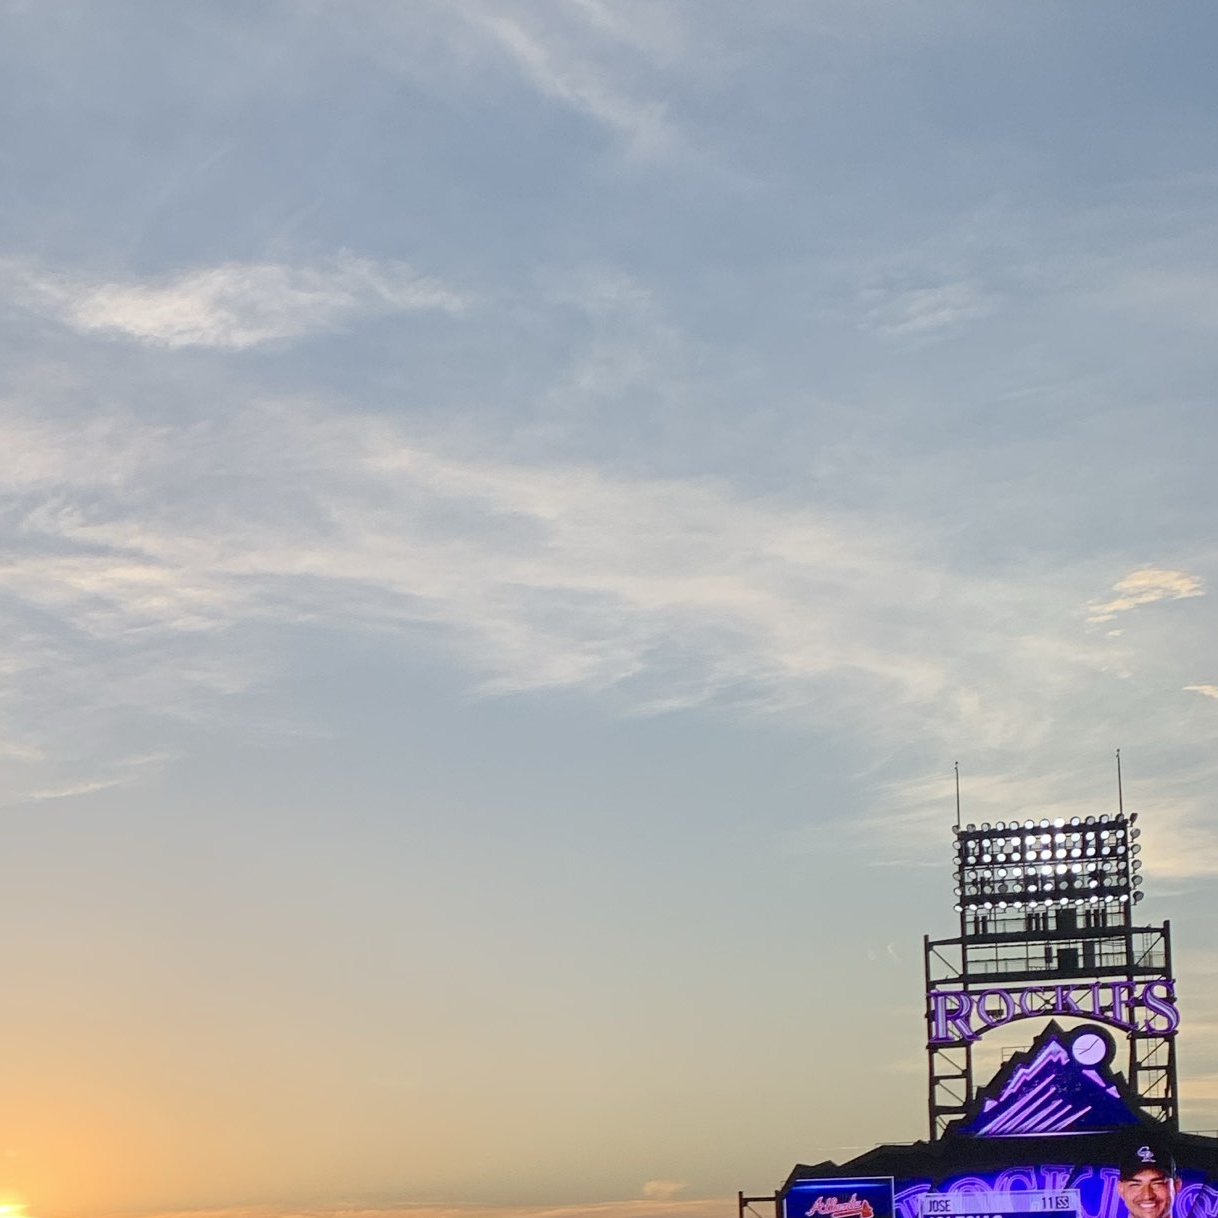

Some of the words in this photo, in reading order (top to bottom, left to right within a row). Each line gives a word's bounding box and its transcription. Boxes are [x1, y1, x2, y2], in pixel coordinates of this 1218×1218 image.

[926, 978, 1180, 1042] ROCKIES
[928, 1199, 951, 1212] JOSE
[1042, 1197, 1053, 1209] 11
[1057, 1197, 1069, 1208] SS
